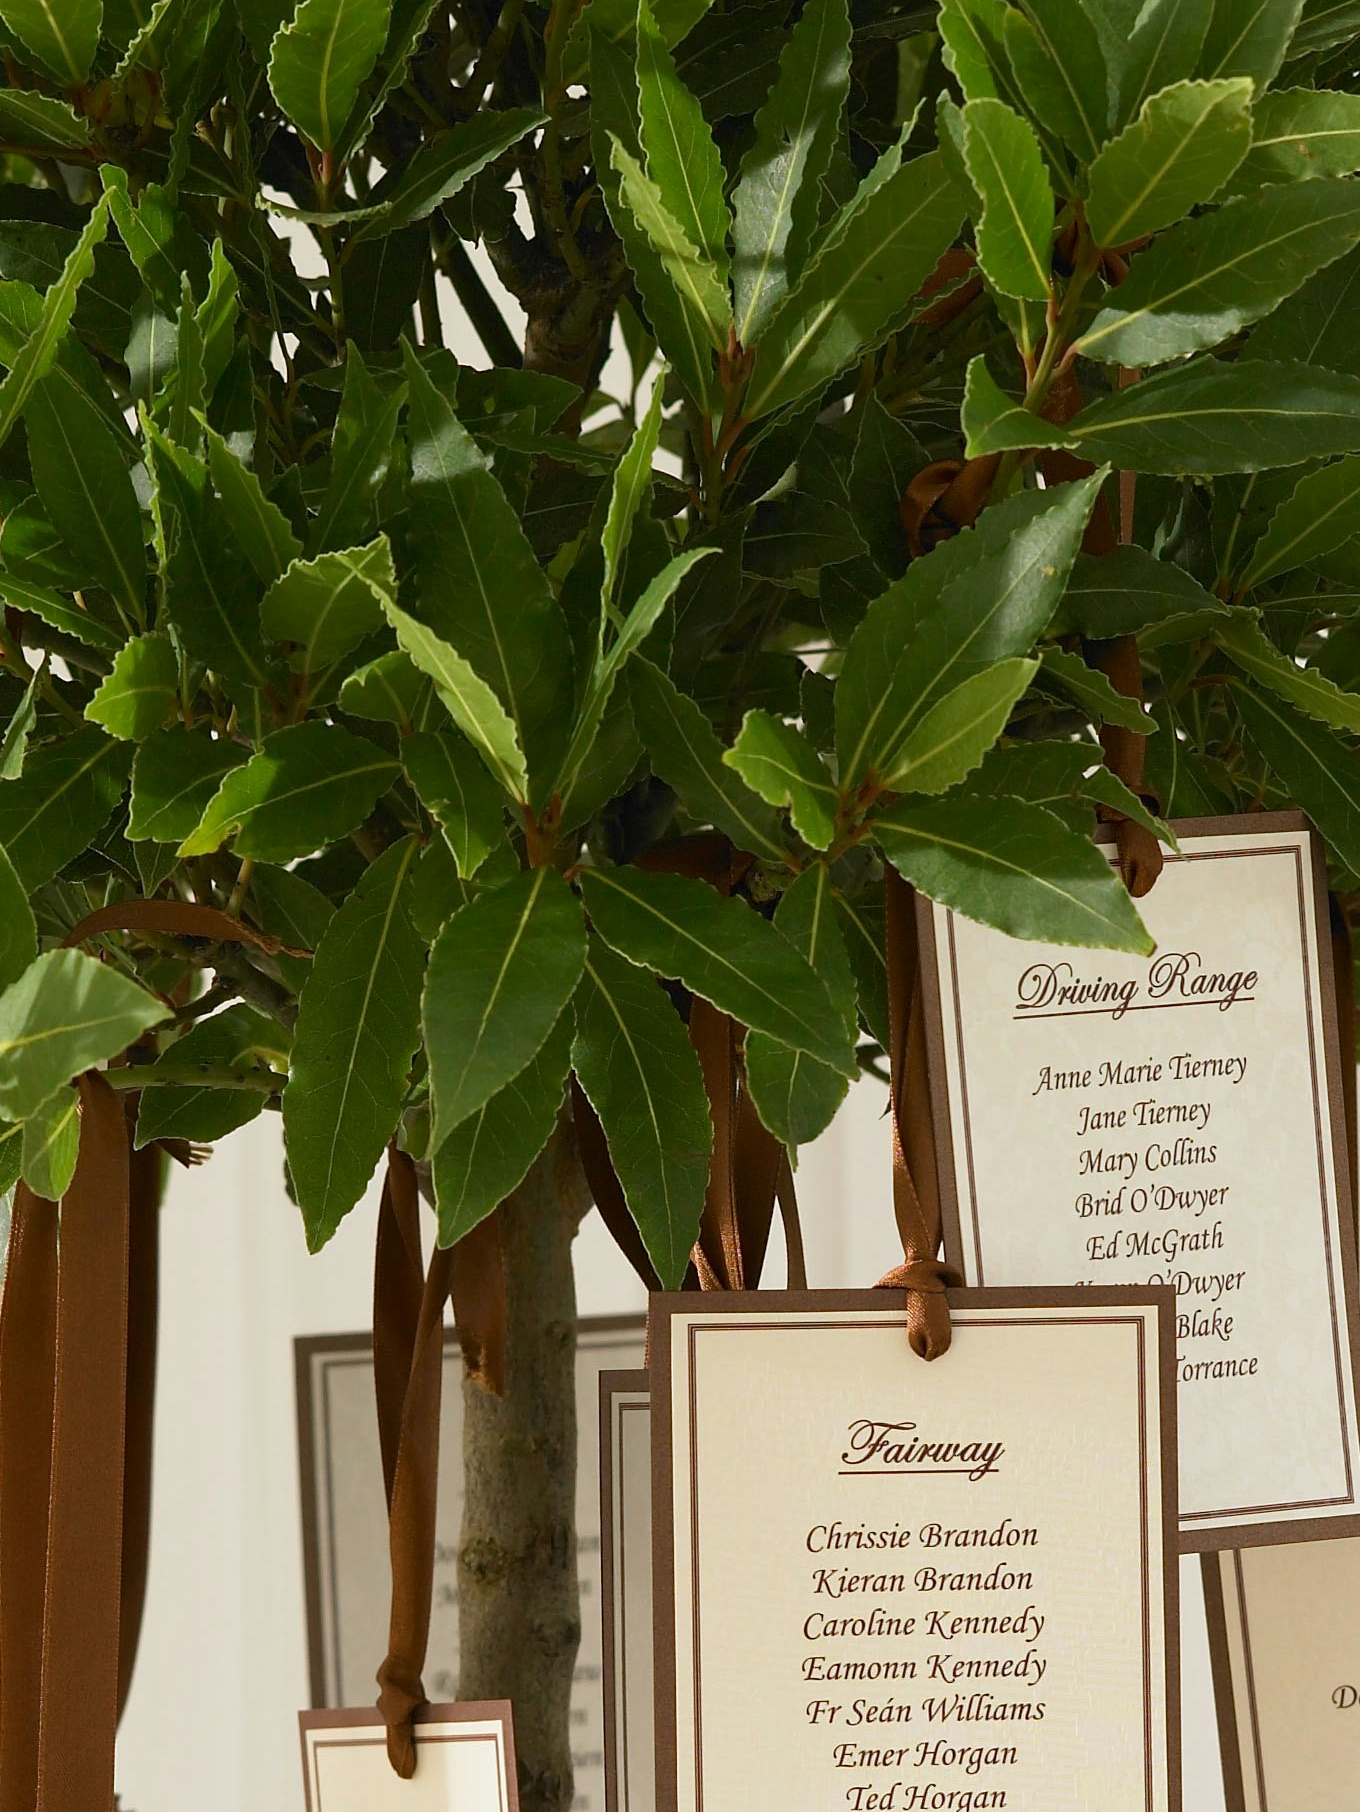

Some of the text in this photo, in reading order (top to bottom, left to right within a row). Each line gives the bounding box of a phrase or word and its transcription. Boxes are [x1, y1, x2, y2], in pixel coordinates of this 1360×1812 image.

[1014, 951, 1259, 1021] Driving Range
[1031, 1052, 1247, 1096] Anne Marie Tierney
[1076, 1098, 1211, 1136] Jane Tierney
[1079, 1136, 1217, 1181] Mary Collins
[1075, 1183, 1230, 1218] Brid O'Dwyer
[1086, 1220, 1224, 1263] Ed McGrath
[1176, 1307, 1234, 1342] Blake
[840, 1418, 1006, 1482] Fairway
[806, 1518, 1039, 1553] Chrissie Brandon
[812, 1561, 1033, 1599] Kieran Brandon
[803, 1605, 1045, 1643] Caroline Kennedy
[801, 1648, 1047, 1687] Eamonn Kennedy
[806, 1692, 1047, 1727] Fr Seán Williams
[833, 1739, 1018, 1775] Emer Horgan
[845, 1781, 903, 1811] Ted
